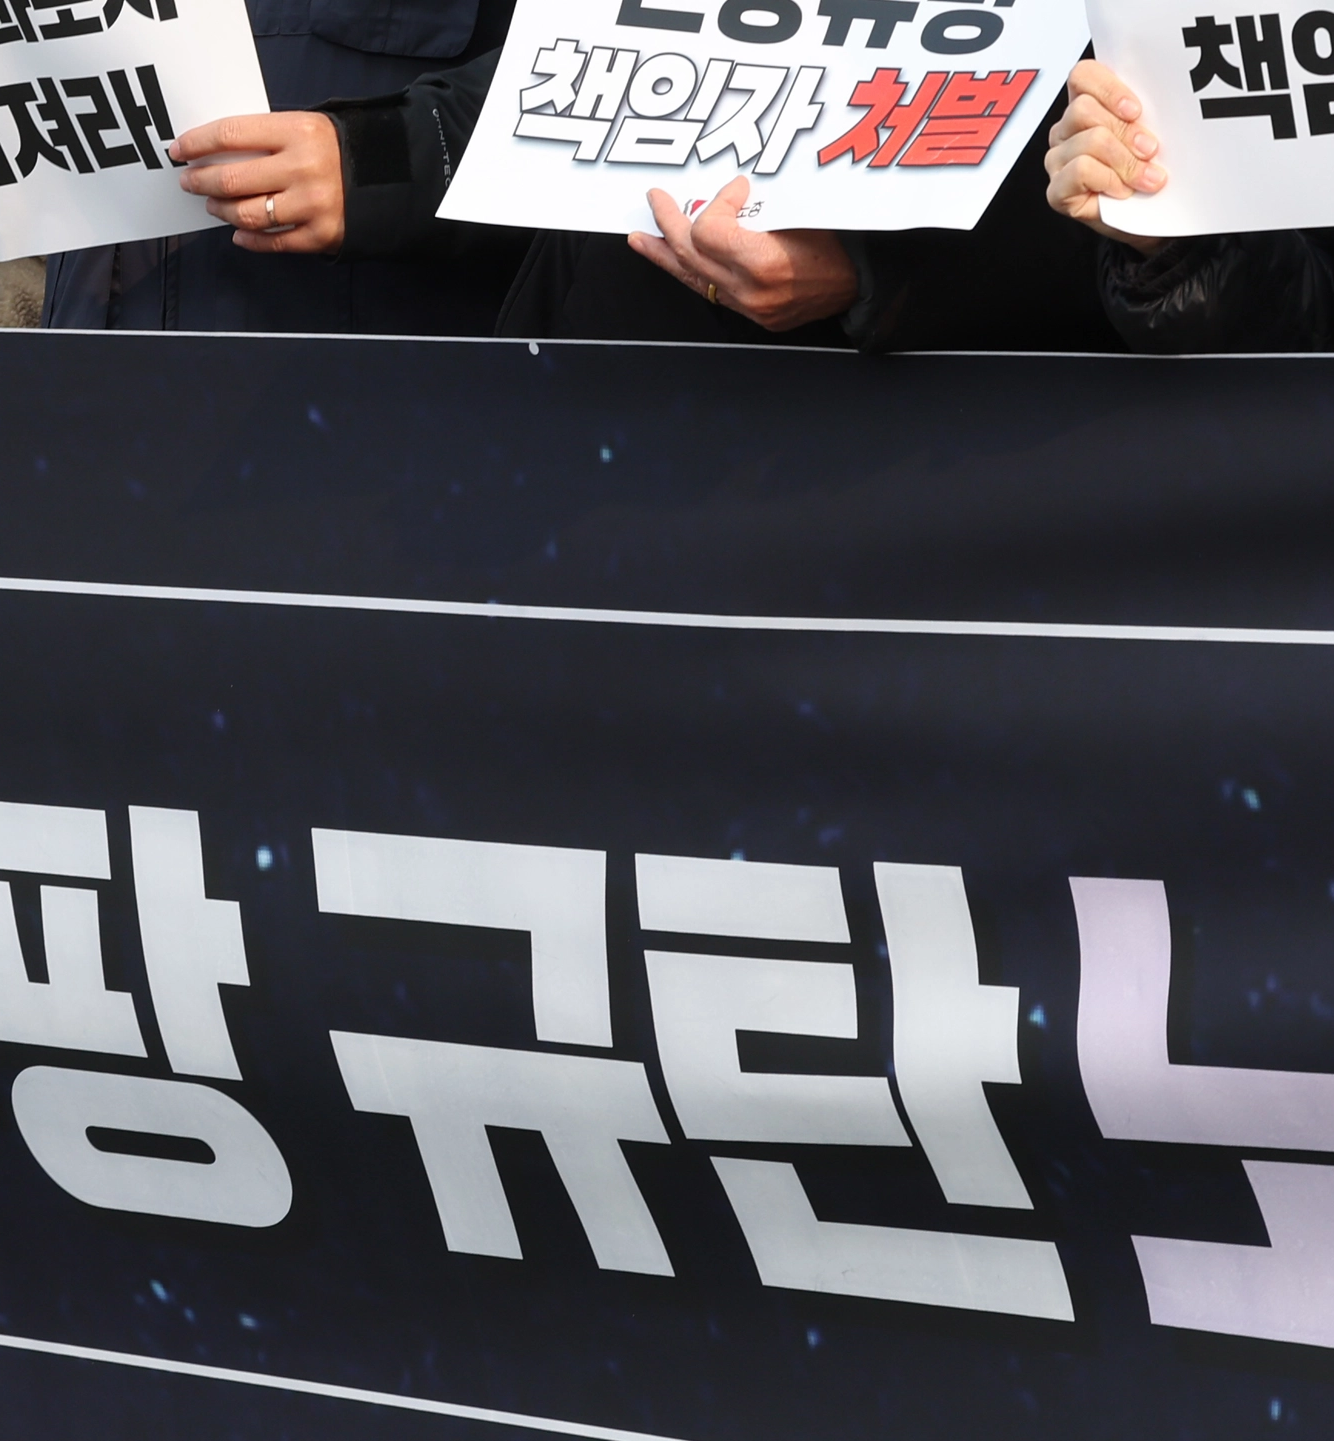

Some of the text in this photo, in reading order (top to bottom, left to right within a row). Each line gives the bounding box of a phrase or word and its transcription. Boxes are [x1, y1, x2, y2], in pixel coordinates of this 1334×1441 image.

[513, 38, 1040, 176] 책임자 처벌
[311, 827, 1076, 1323] 규탄
